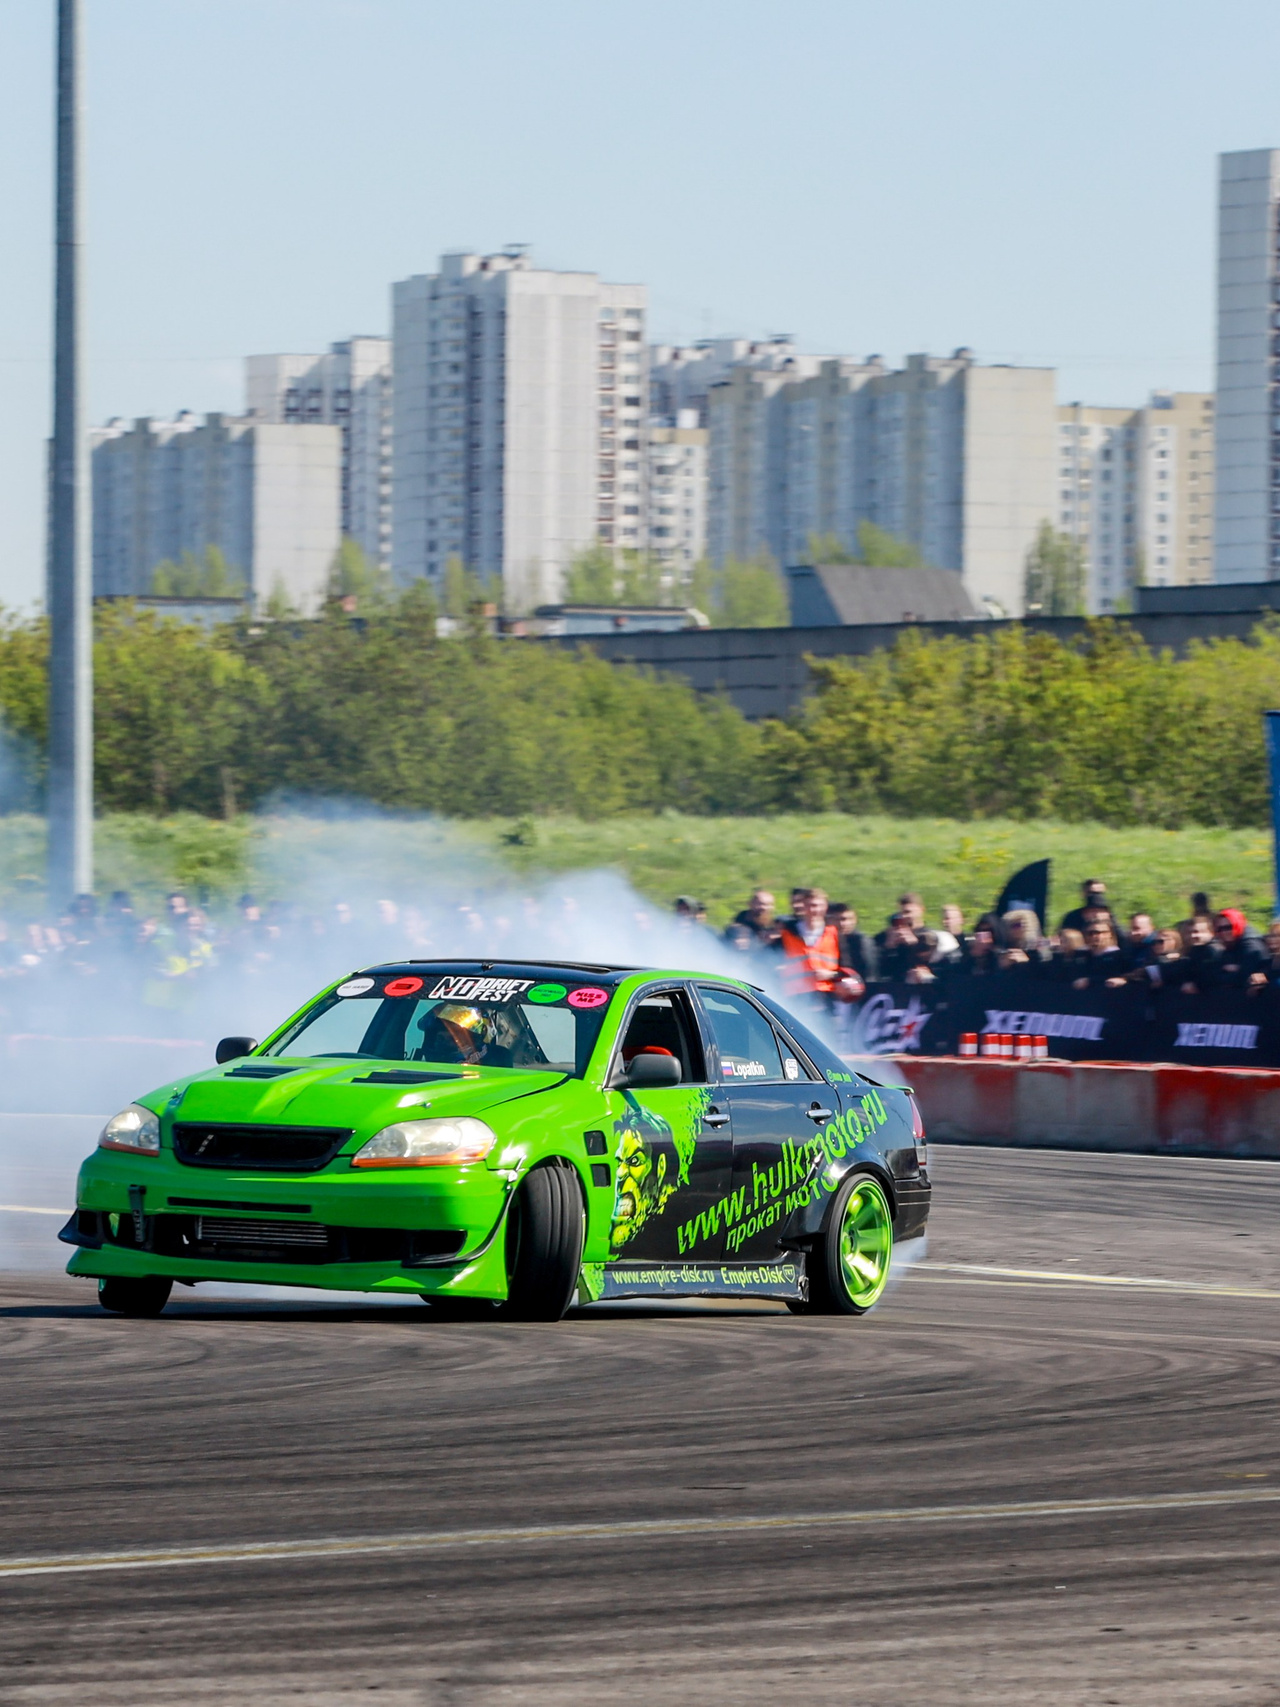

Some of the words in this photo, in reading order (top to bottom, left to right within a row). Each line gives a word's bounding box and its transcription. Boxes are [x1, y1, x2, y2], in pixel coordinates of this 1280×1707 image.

[478, 979, 535, 991] DRIFT
[471, 989, 518, 1002] FEST
[731, 1061, 766, 1079] Lopatkin
[677, 1089, 888, 1255] www.hulkmoto.ru
[726, 1200, 782, 1253] прокат
[612, 1265, 715, 1287] www.empire-disk.ru
